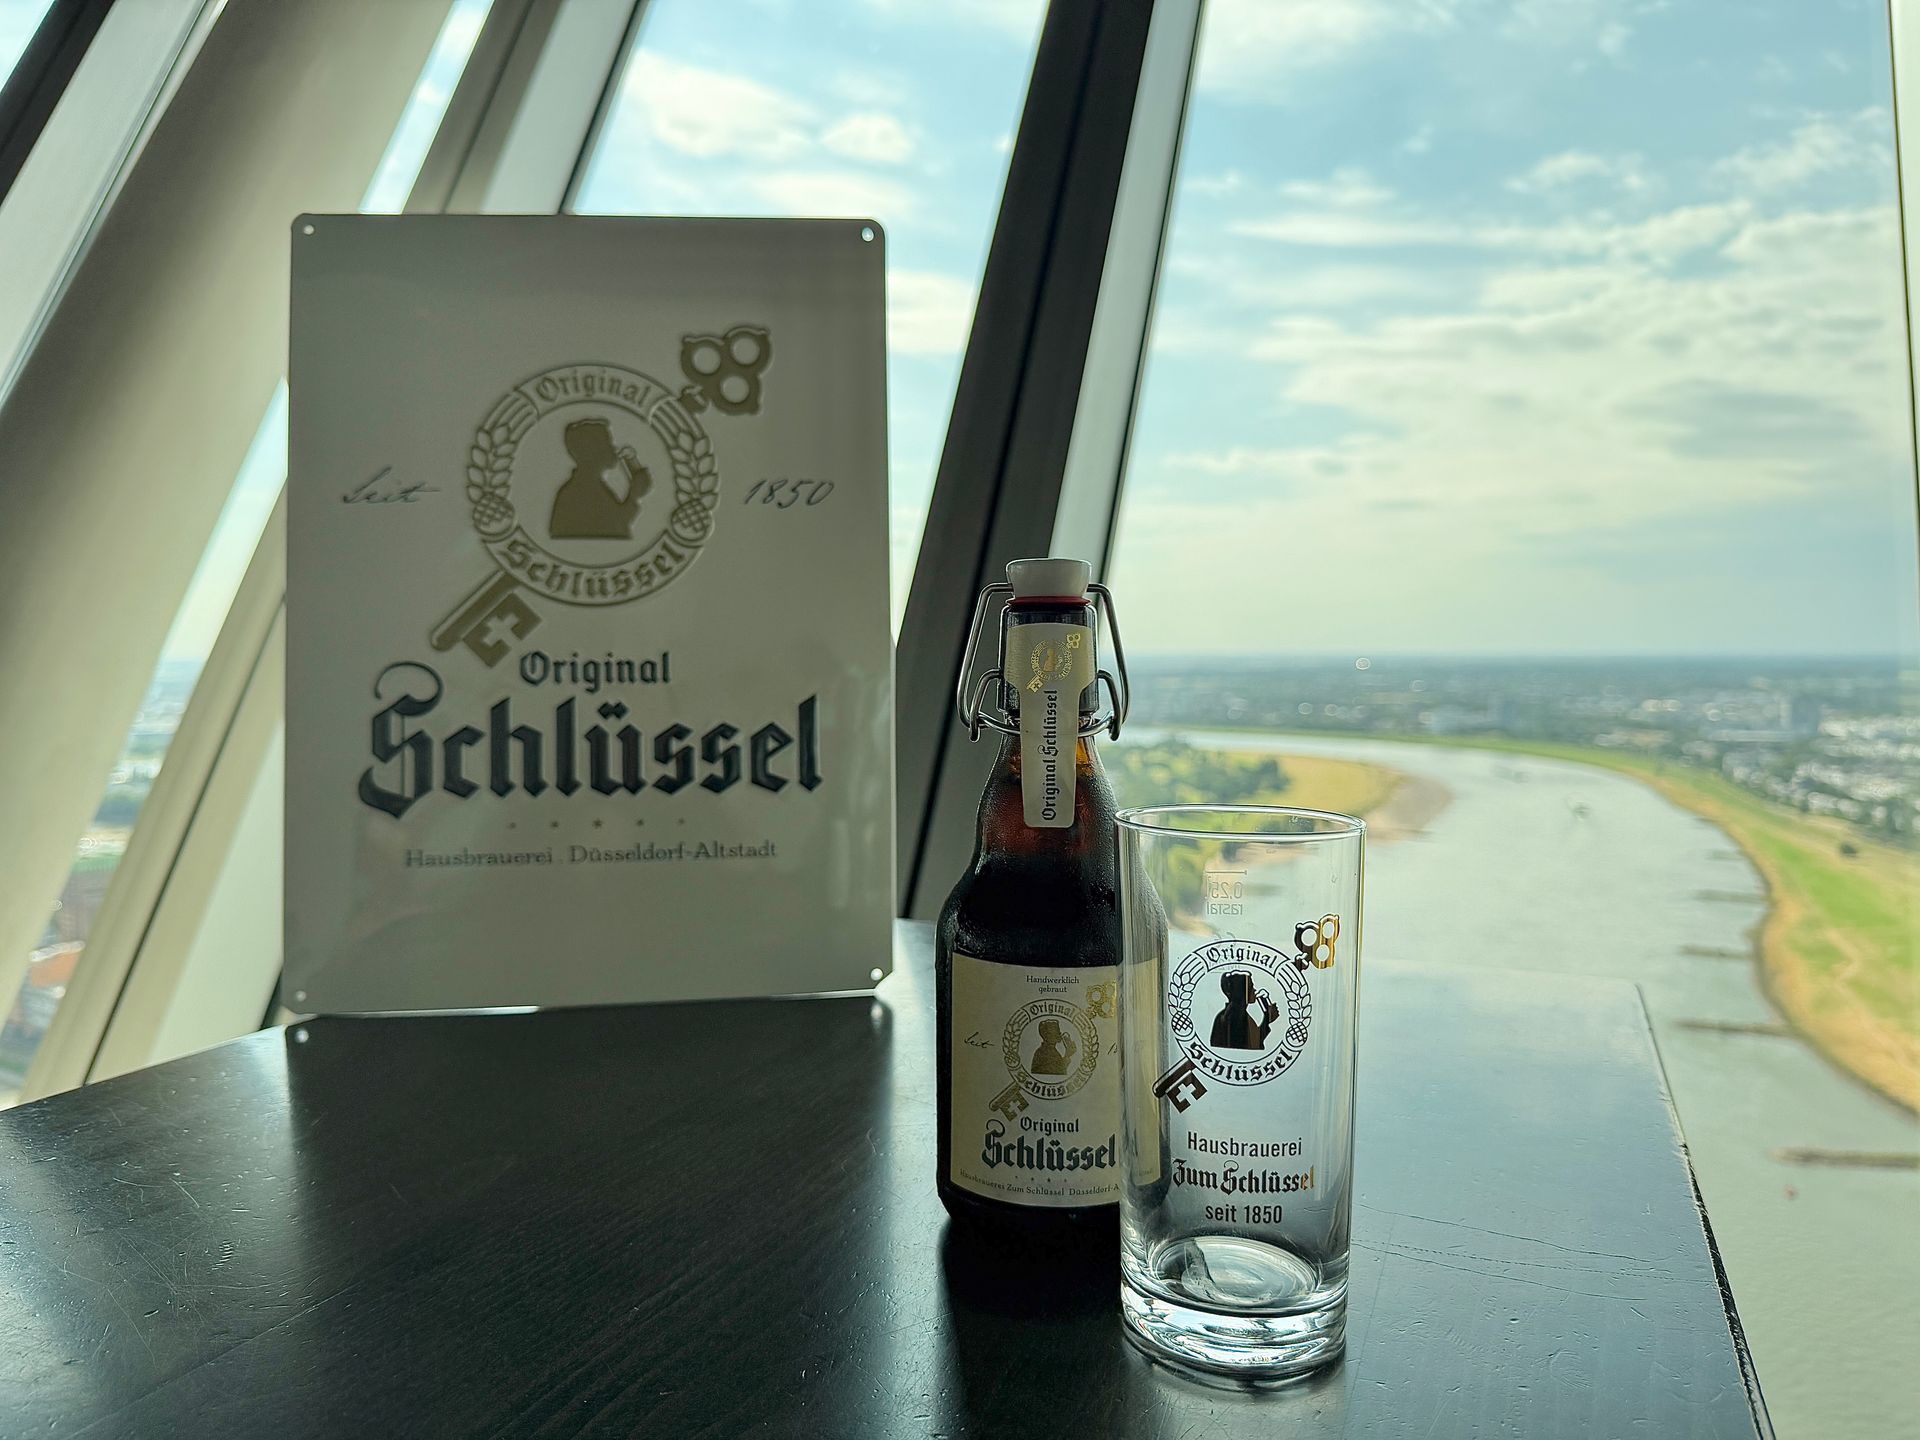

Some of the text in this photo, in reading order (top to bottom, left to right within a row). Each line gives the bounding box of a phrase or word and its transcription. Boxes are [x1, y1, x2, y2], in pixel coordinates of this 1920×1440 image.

[535, 372, 651, 408] Original
[743, 480, 834, 508] 1850
[506, 538, 684, 598] Schlüssel
[520, 650, 671, 693] Original
[1038, 689, 1060, 757] Schlüssel
[358, 660, 823, 819] Schlüssel
[1042, 758, 1060, 821] Original
[404, 839, 777, 869] Hausbrauerei Düsseldorf-Altstadt
[1206, 944, 1278, 969] Original
[1026, 975, 1080, 985] Handwerklich
[1038, 985, 1067, 995] gebraut
[1029, 1001, 1076, 1018] Original
[1185, 1041, 1293, 1082] Schlüssel
[1020, 1116, 1080, 1137] Original
[981, 1119, 1117, 1172] Schlüssel
[1187, 1131, 1302, 1157] Hausbrauerei
[1006, 1183, 1025, 1193] Zum
[1069, 1183, 1120, 1196] Düsseldorf-A
[1172, 1158, 1315, 1195] Zum Schlüssel
[1205, 1204, 1283, 1224] seit 1850
